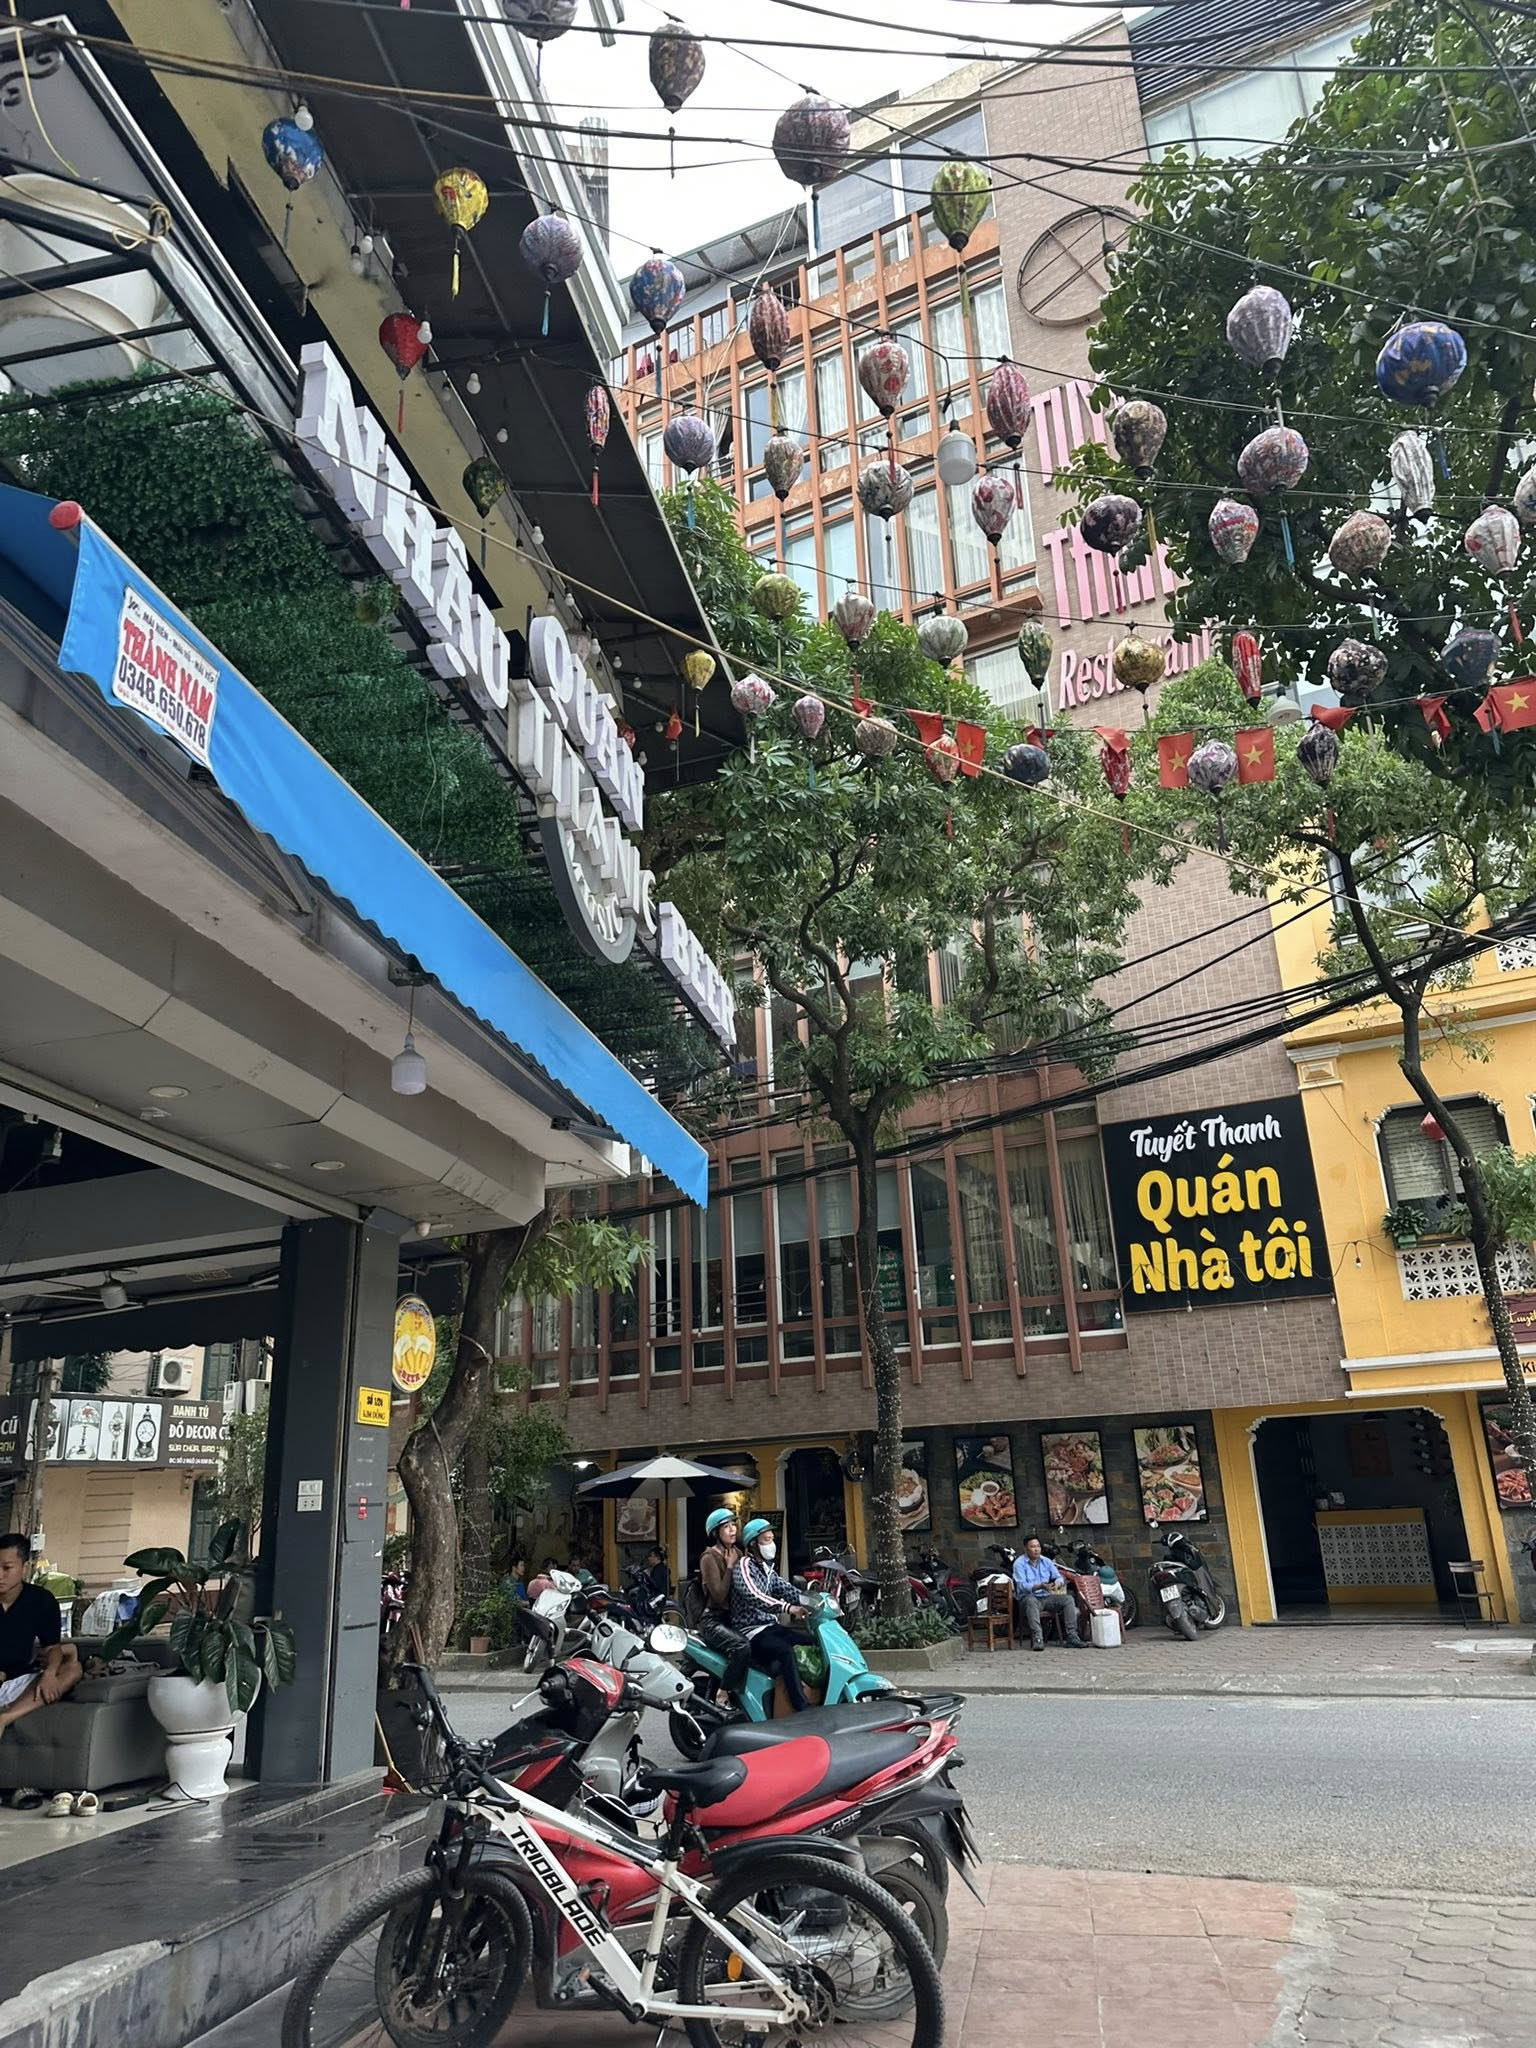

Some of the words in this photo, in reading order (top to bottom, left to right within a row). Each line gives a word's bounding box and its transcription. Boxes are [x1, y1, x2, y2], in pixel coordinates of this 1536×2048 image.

[118, 654, 207, 750] 0348.650.678
[180, 667, 213, 725] NAM
[295, 340, 511, 710] NHẬU
[508, 679, 657, 936] TITANIC
[658, 901, 738, 1045] BEER
[1129, 1119, 1198, 1163] Tuyết
[1201, 1114, 1282, 1148] Thanh
[1136, 1152, 1282, 1234] Quán
[1129, 1226, 1235, 1295] Nhà
[1239, 1216, 1313, 1283] tôi
[173, 1404, 197, 1417] DANH
[185, 1424, 218, 1440] DECOR
[509, 1825, 607, 1948] TRIOBLADE
